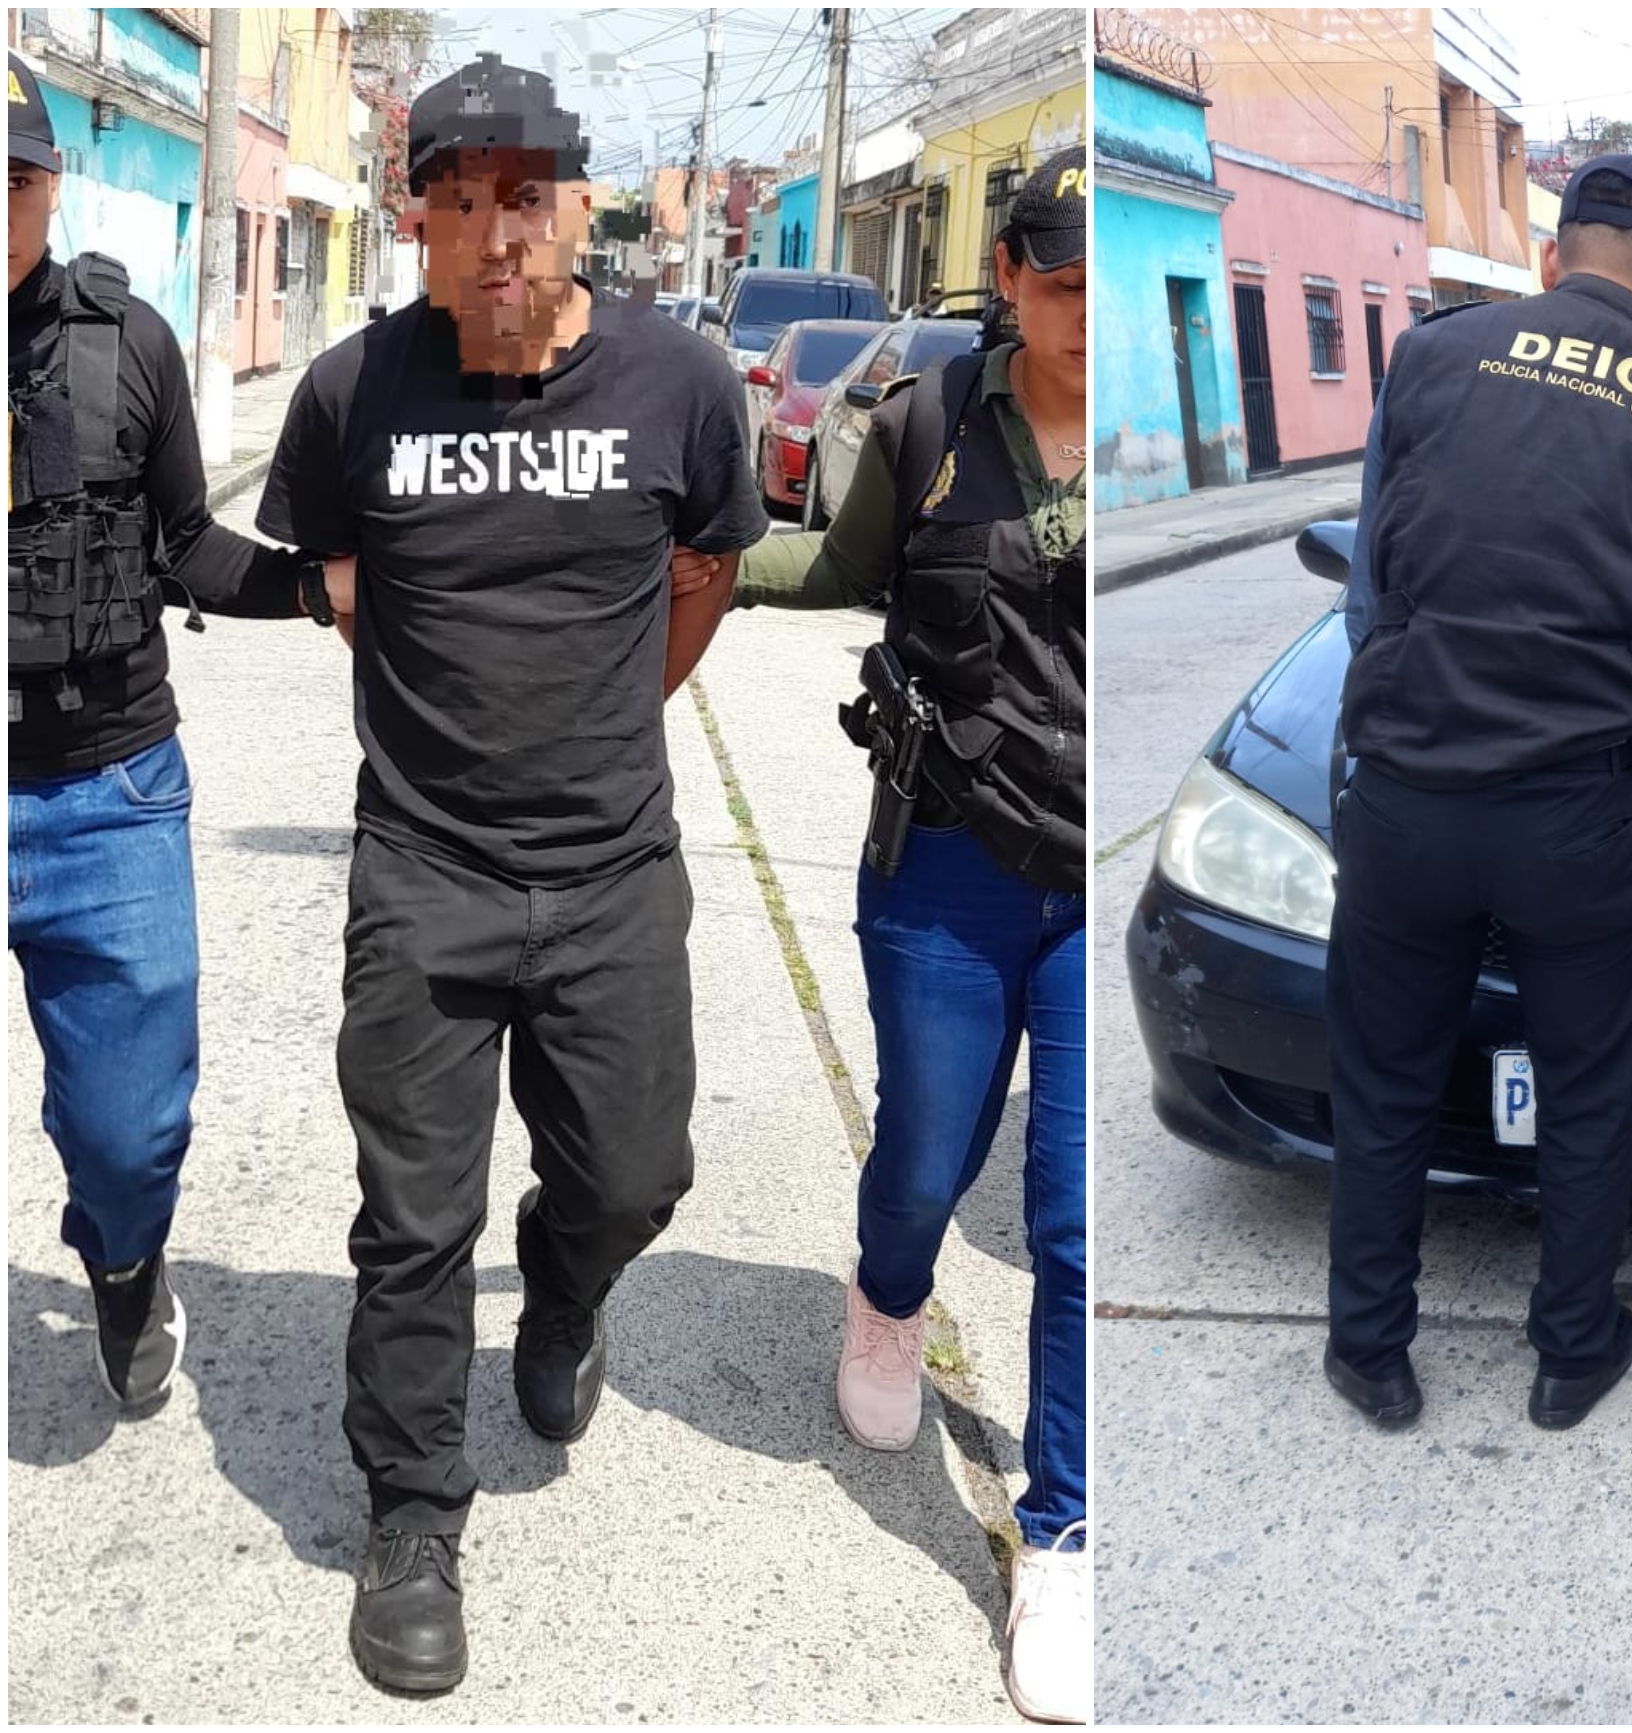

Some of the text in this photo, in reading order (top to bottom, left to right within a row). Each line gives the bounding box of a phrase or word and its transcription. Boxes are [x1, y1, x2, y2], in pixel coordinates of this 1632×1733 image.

[1478, 359, 1540, 382] POLICIA
[1545, 371, 1626, 407] NACIONAL
[387, 428, 630, 499] WESTSIDE
